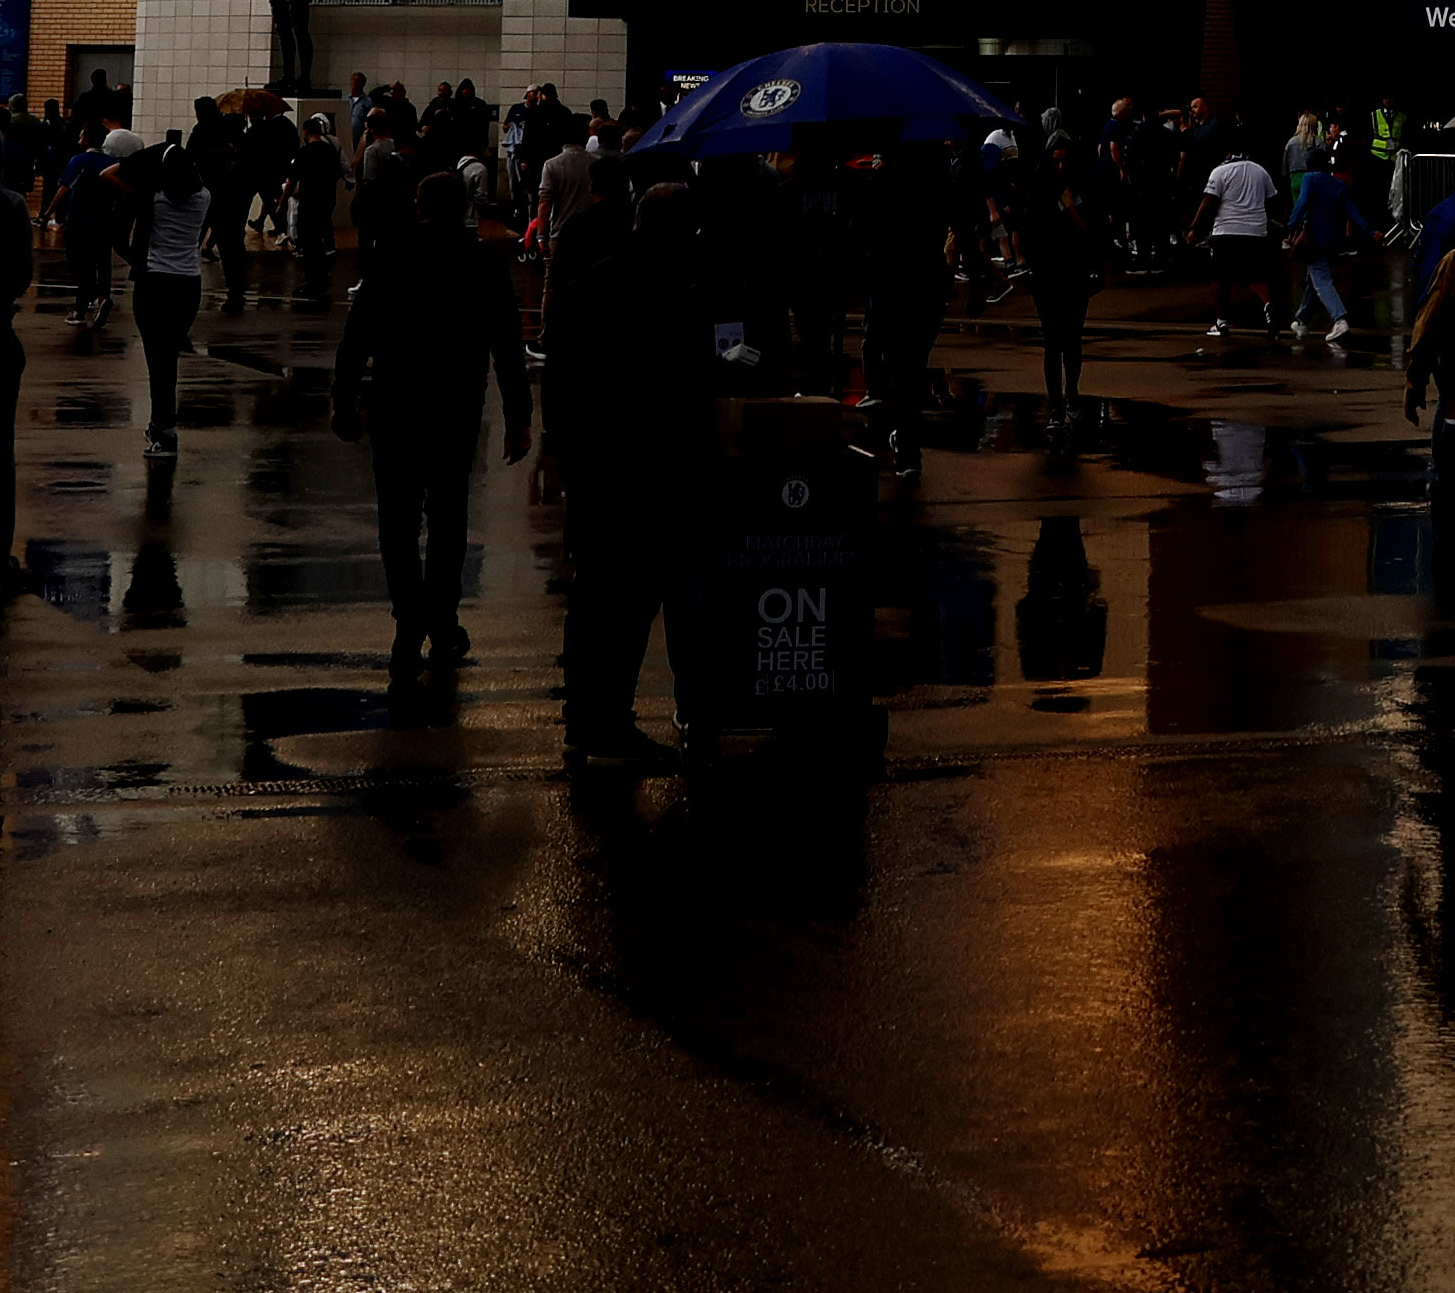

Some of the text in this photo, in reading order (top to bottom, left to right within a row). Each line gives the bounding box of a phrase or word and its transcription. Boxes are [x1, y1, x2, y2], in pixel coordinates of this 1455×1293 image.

[757, 586, 827, 624] ON
[757, 625, 827, 649] SALE
[757, 649, 826, 672] HERE
[773, 671, 829, 693] £4.00
